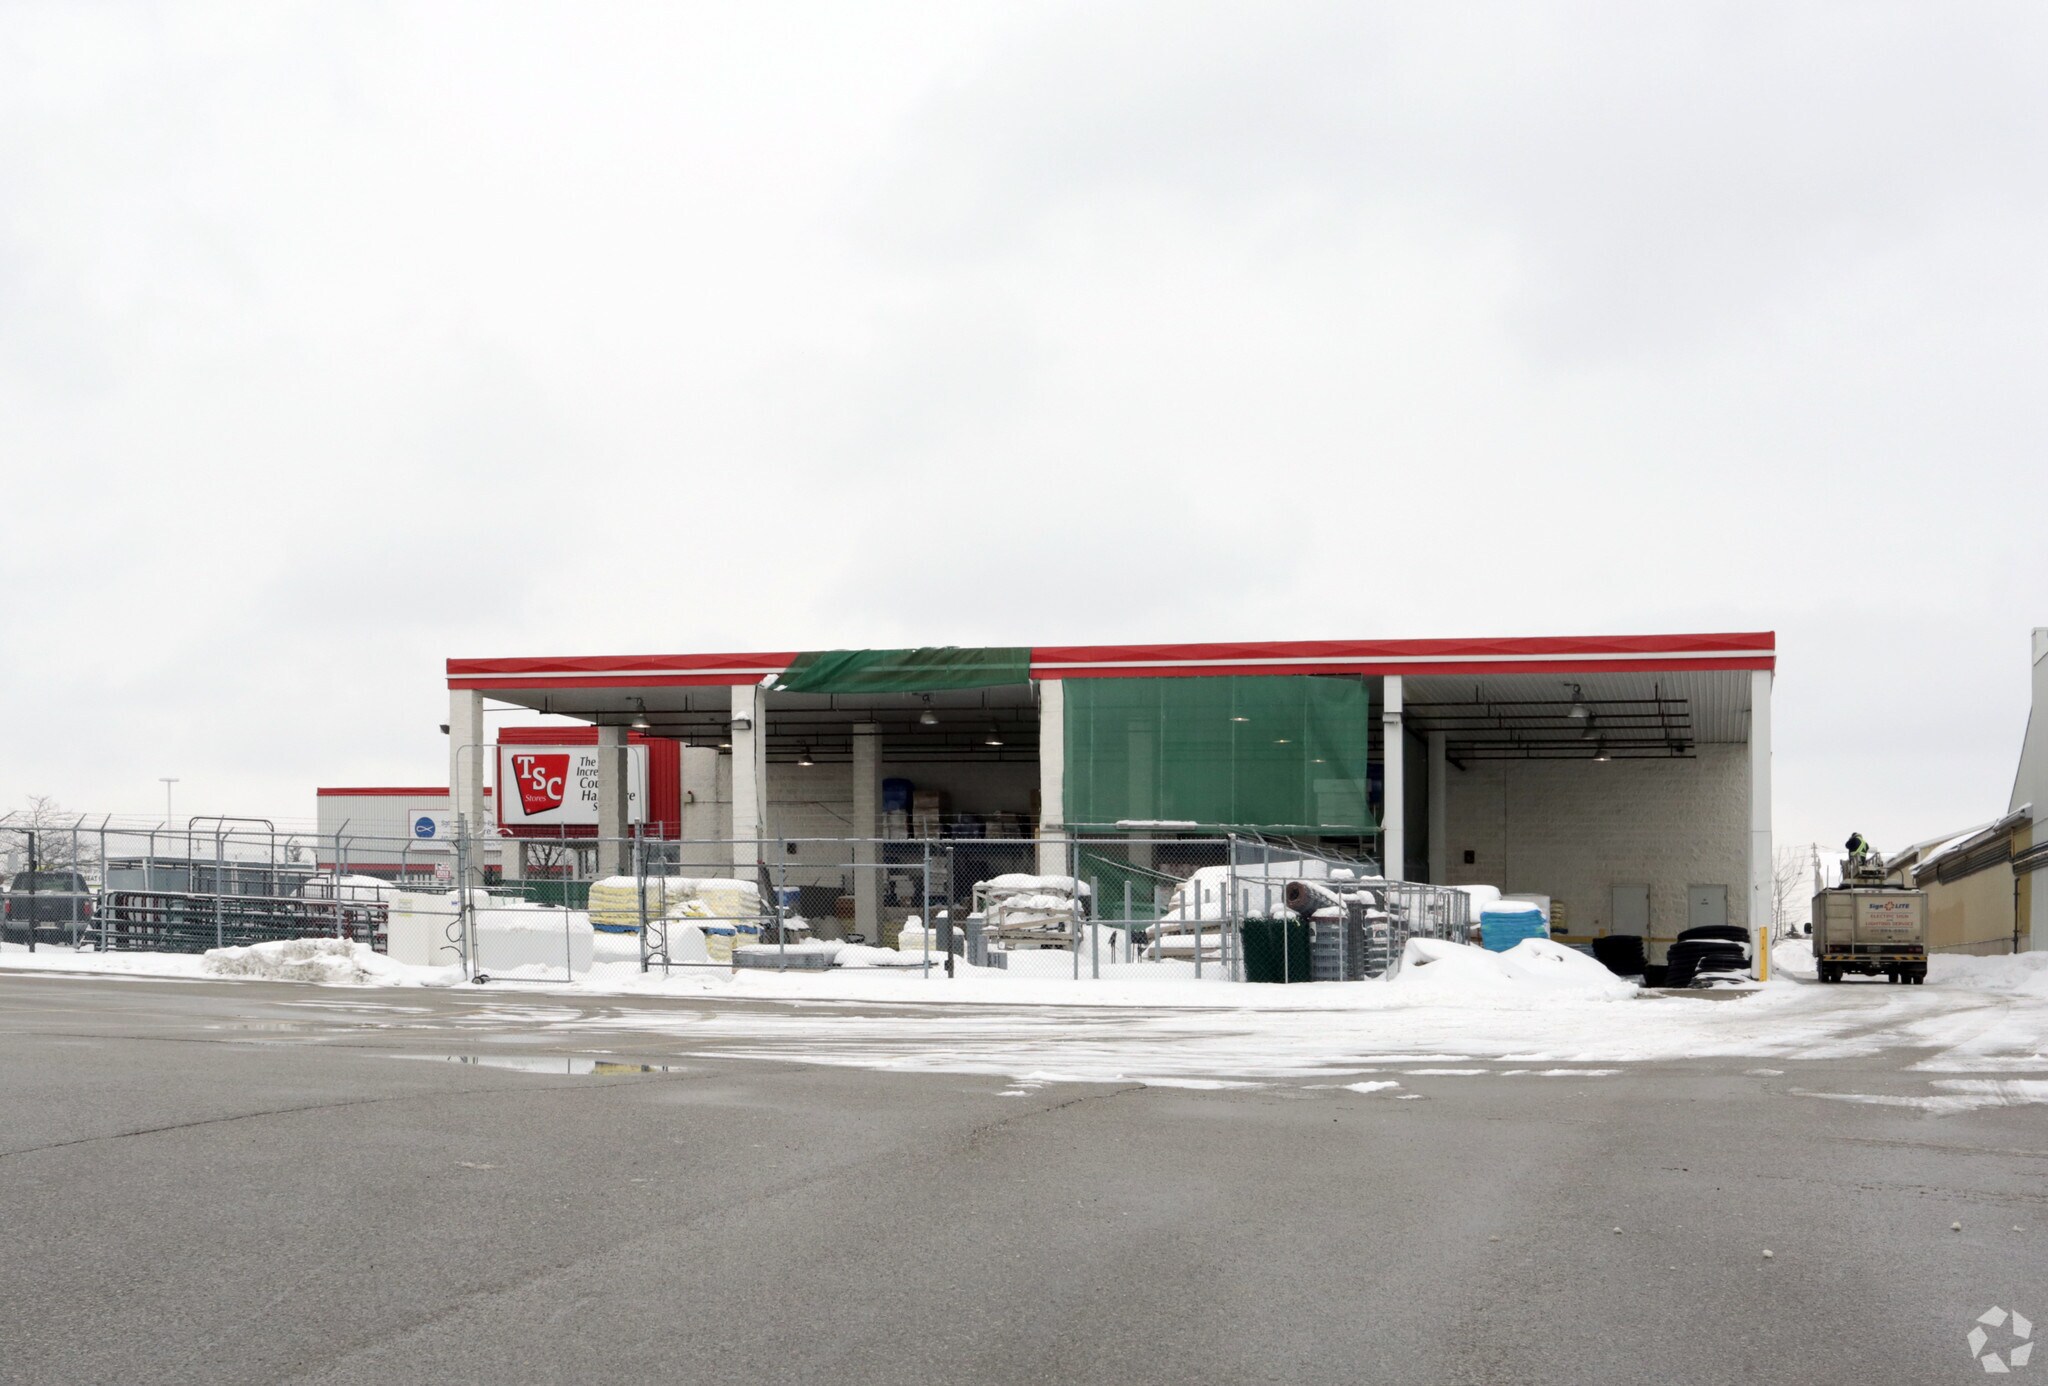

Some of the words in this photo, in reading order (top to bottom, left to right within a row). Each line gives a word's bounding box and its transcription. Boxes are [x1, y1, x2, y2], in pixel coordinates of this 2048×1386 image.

[580, 756, 596, 767] The
[576, 766, 599, 777] Incre
[517, 756, 562, 800] TSC
[525, 794, 547, 802] Stores
